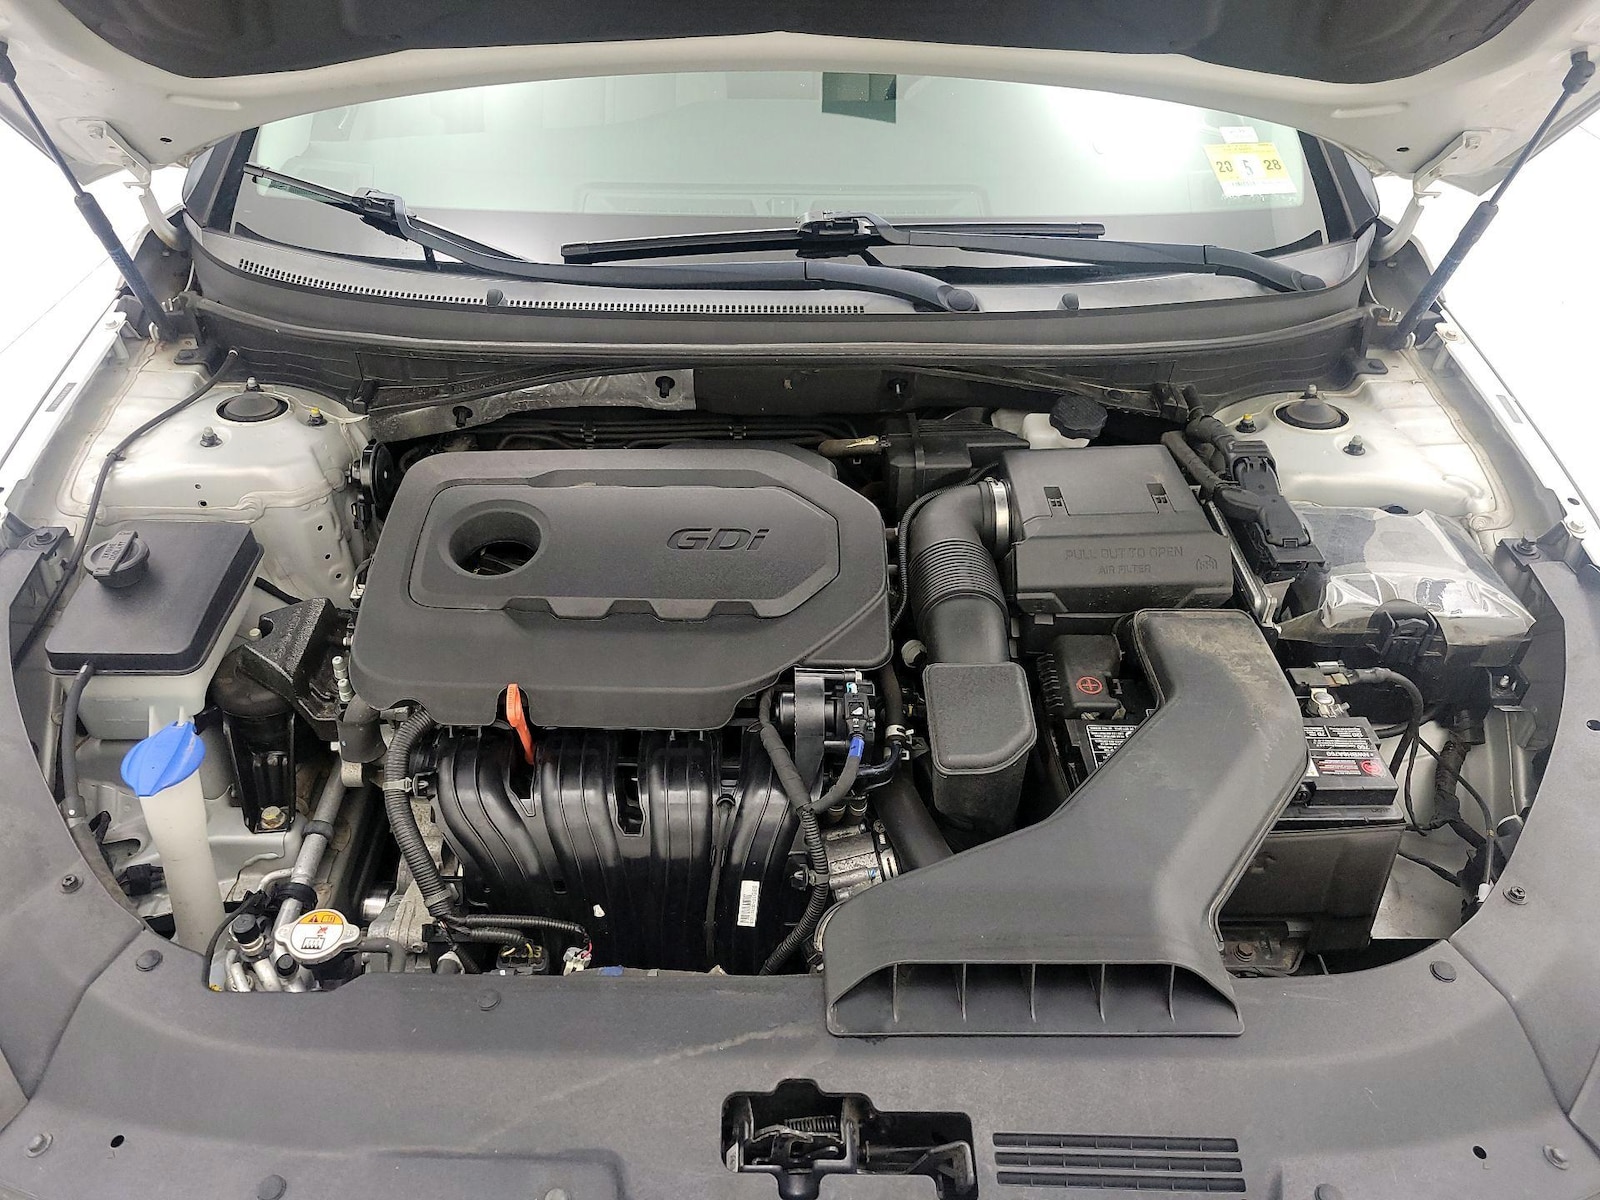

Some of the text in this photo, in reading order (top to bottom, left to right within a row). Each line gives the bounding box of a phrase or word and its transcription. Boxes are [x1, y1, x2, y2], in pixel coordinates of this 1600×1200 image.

[1216, 159, 1282, 176] 20 5 28
[666, 526, 771, 552] GDi
[1065, 545, 1183, 560] PULL OUT TO OPEN
[1098, 564, 1151, 575] AIR FILTER
